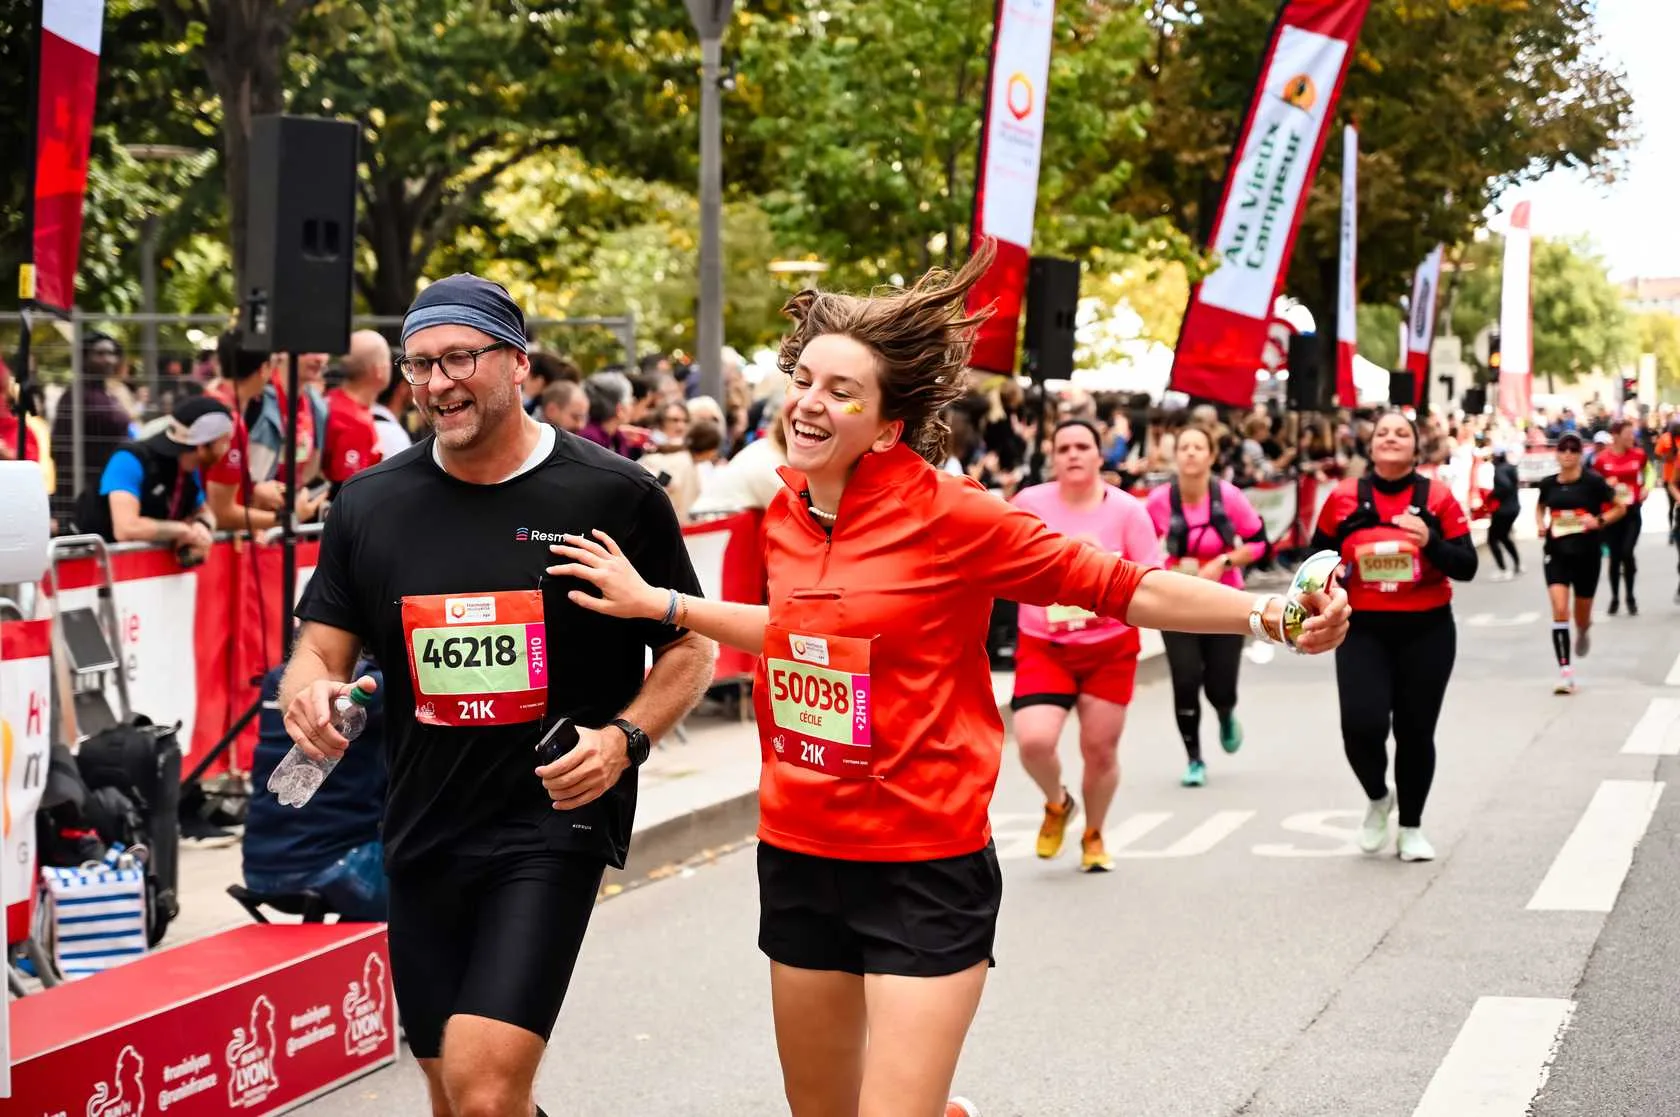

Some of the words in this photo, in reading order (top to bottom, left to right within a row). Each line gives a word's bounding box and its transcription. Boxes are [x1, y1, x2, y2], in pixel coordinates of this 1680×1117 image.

[1225, 223, 1248, 268] Au
[1241, 122, 1279, 208] Vieux
[1246, 130, 1300, 269] Campeur
[531, 530, 584, 543] Resm
[423, 635, 517, 668] 46218
[531, 637, 544, 675] +2H10
[773, 669, 849, 714] 50038
[457, 700, 496, 719] 21K
[800, 711, 822, 727] CÉCILE
[855, 689, 867, 731] +2H10
[800, 740, 825, 767] 21K
[352, 1010, 380, 1041] LYON
[236, 1058, 270, 1092] LYON
